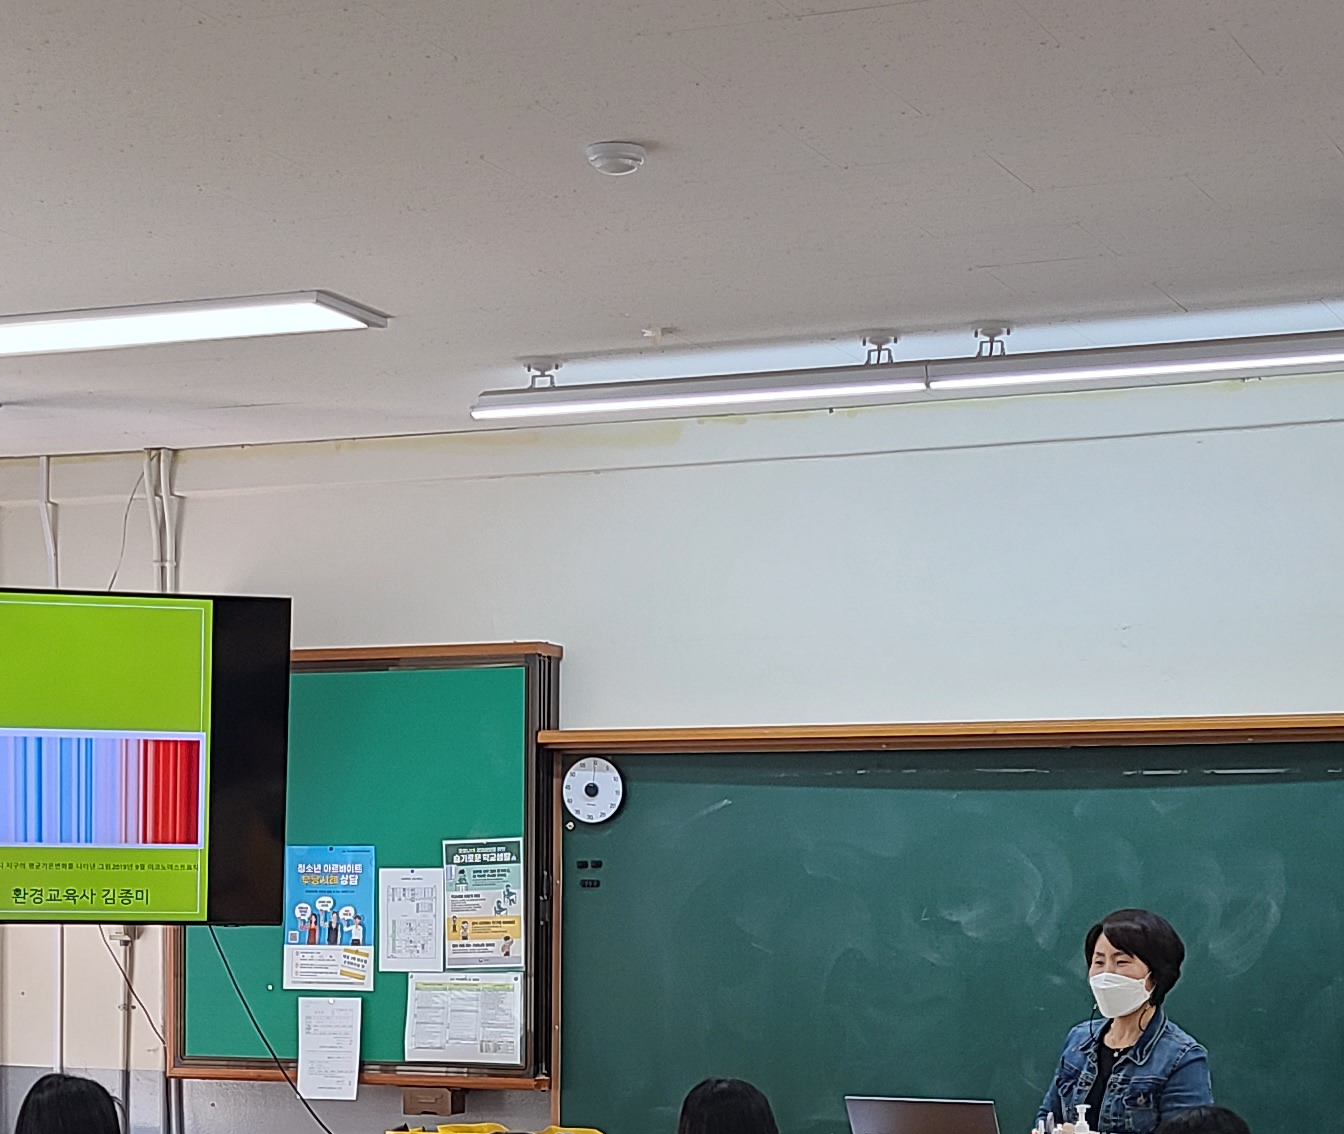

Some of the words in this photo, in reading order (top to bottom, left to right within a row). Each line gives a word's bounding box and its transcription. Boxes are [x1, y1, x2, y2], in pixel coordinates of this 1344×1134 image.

[297, 863, 322, 874] 청소년
[340, 874, 358, 886] 상담
[12, 888, 96, 905] 환경교육사
[102, 888, 149, 906] 김종미
